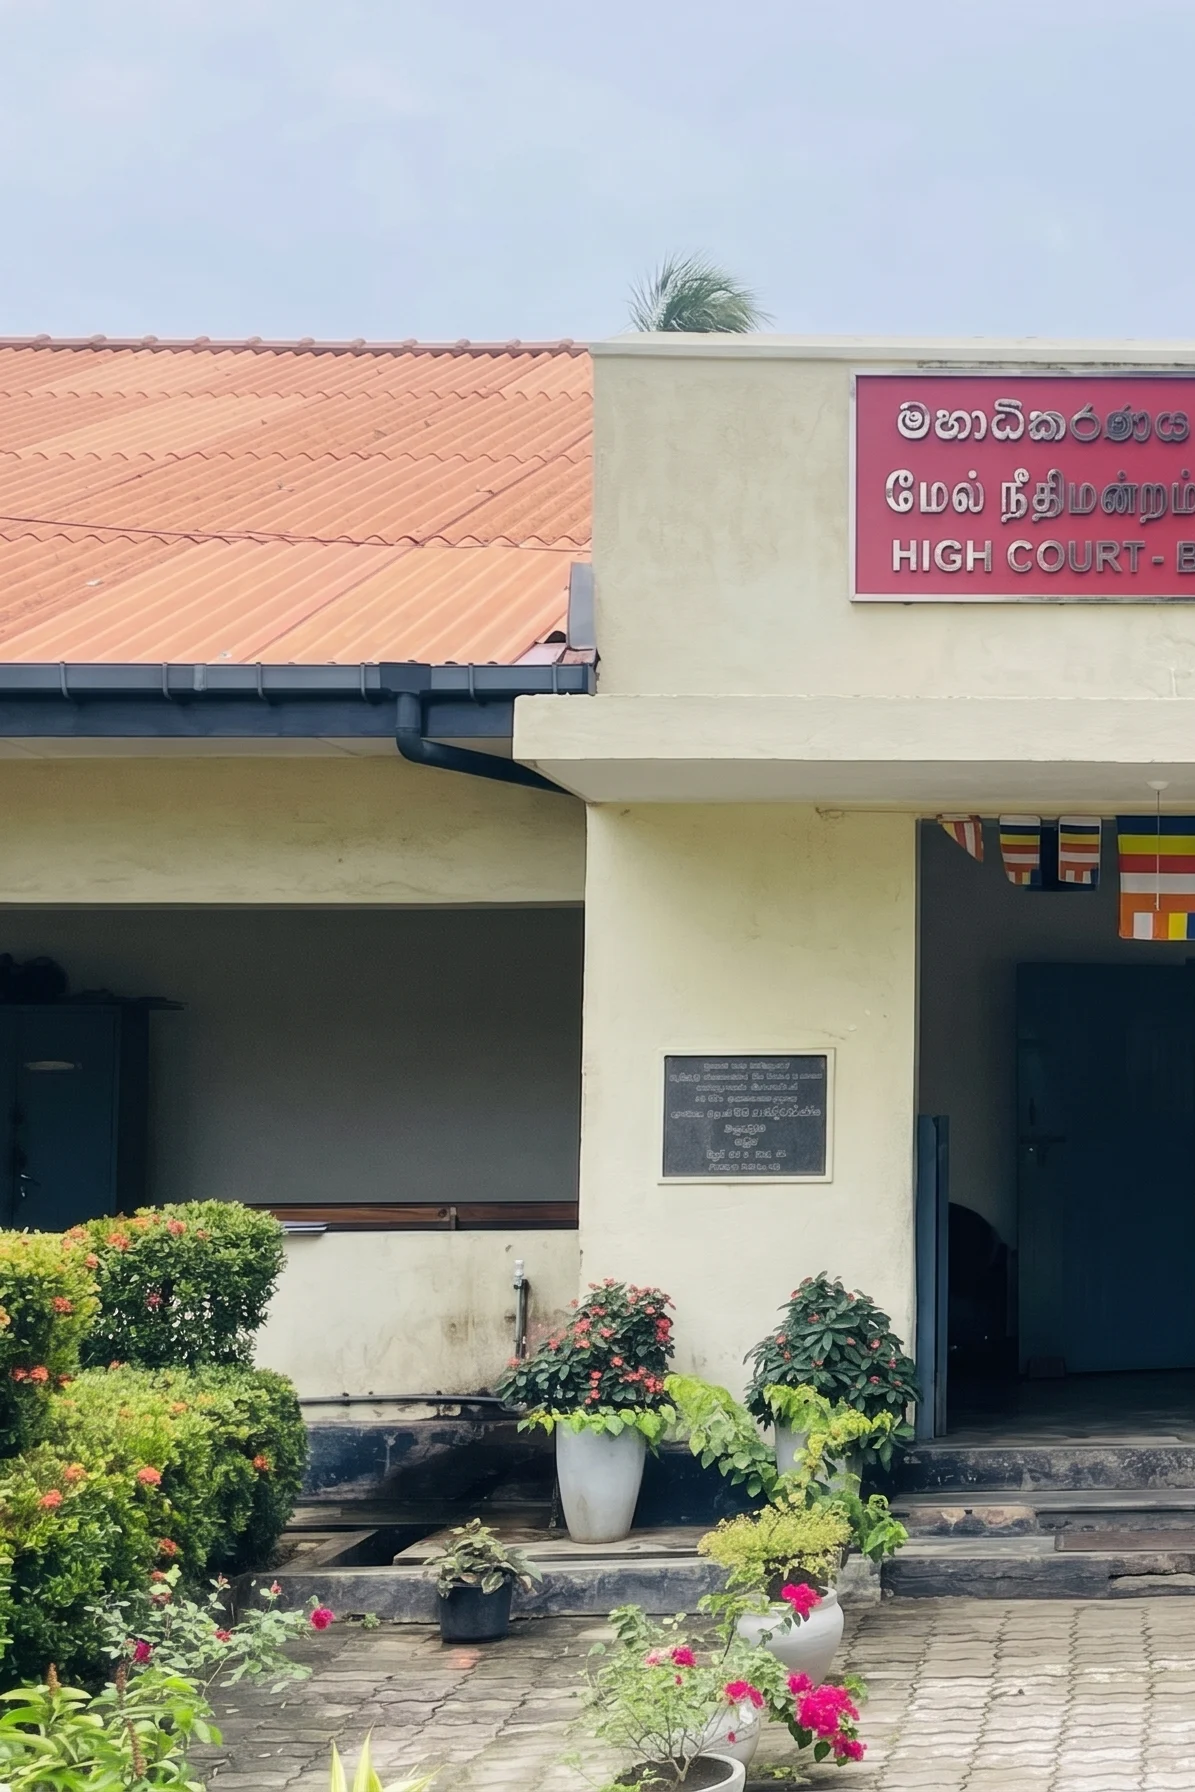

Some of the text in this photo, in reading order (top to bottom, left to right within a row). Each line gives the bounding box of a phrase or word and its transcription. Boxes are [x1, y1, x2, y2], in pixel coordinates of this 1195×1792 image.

[885, 469, 985, 514] மேல்
[892, 540, 992, 572] HIGH
[1007, 540, 1146, 573] COURT
